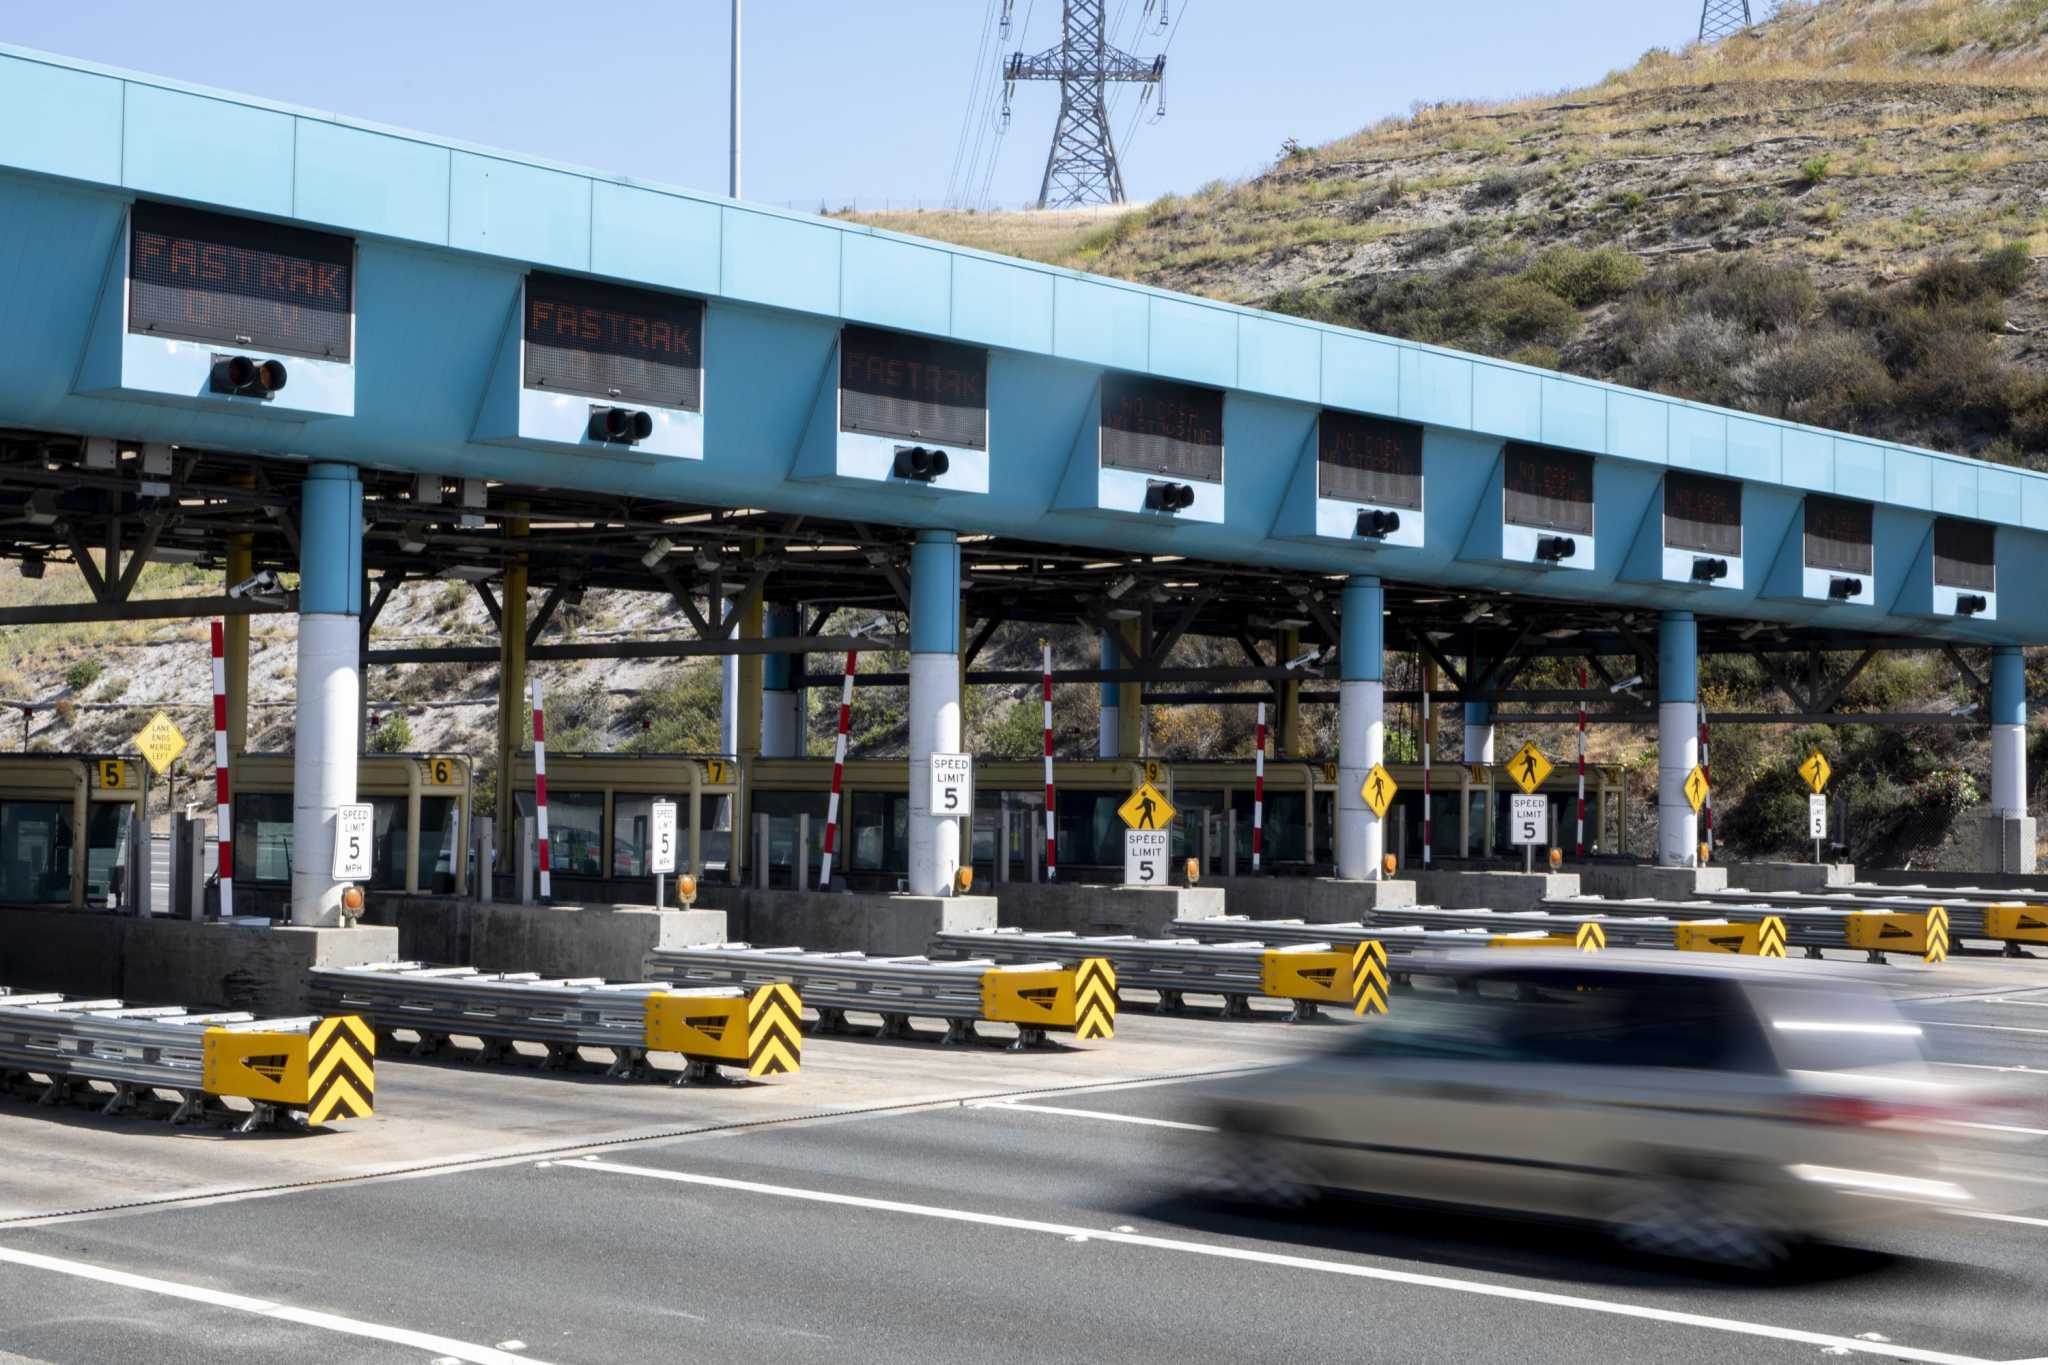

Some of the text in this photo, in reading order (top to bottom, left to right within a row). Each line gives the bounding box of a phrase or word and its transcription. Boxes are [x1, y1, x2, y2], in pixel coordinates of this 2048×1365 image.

[140, 235, 343, 299] FASTRAK
[531, 302, 691, 353] FASTRAK
[435, 761, 448, 783] 6
[711, 762, 722, 782] 7
[934, 759, 969, 770] SPEED
[1150, 763, 1157, 781] 9
[105, 763, 119, 786] 5
[937, 773, 965, 783] LIMIT
[944, 787, 958, 809] 5
[1514, 799, 1545, 808] SPEED
[342, 809, 369, 820] SPEED
[1517, 810, 1542, 819] LIMIT
[344, 822, 366, 833] LIMIT
[1524, 821, 1536, 839] 5
[1815, 818, 1822, 834] 5
[349, 836, 360, 859] 5
[661, 833, 669, 854] 5
[1129, 834, 1166, 845] SPEED
[1132, 848, 1162, 857] LIMIT
[344, 863, 362, 873] MPH
[1140, 861, 1154, 880] 5
